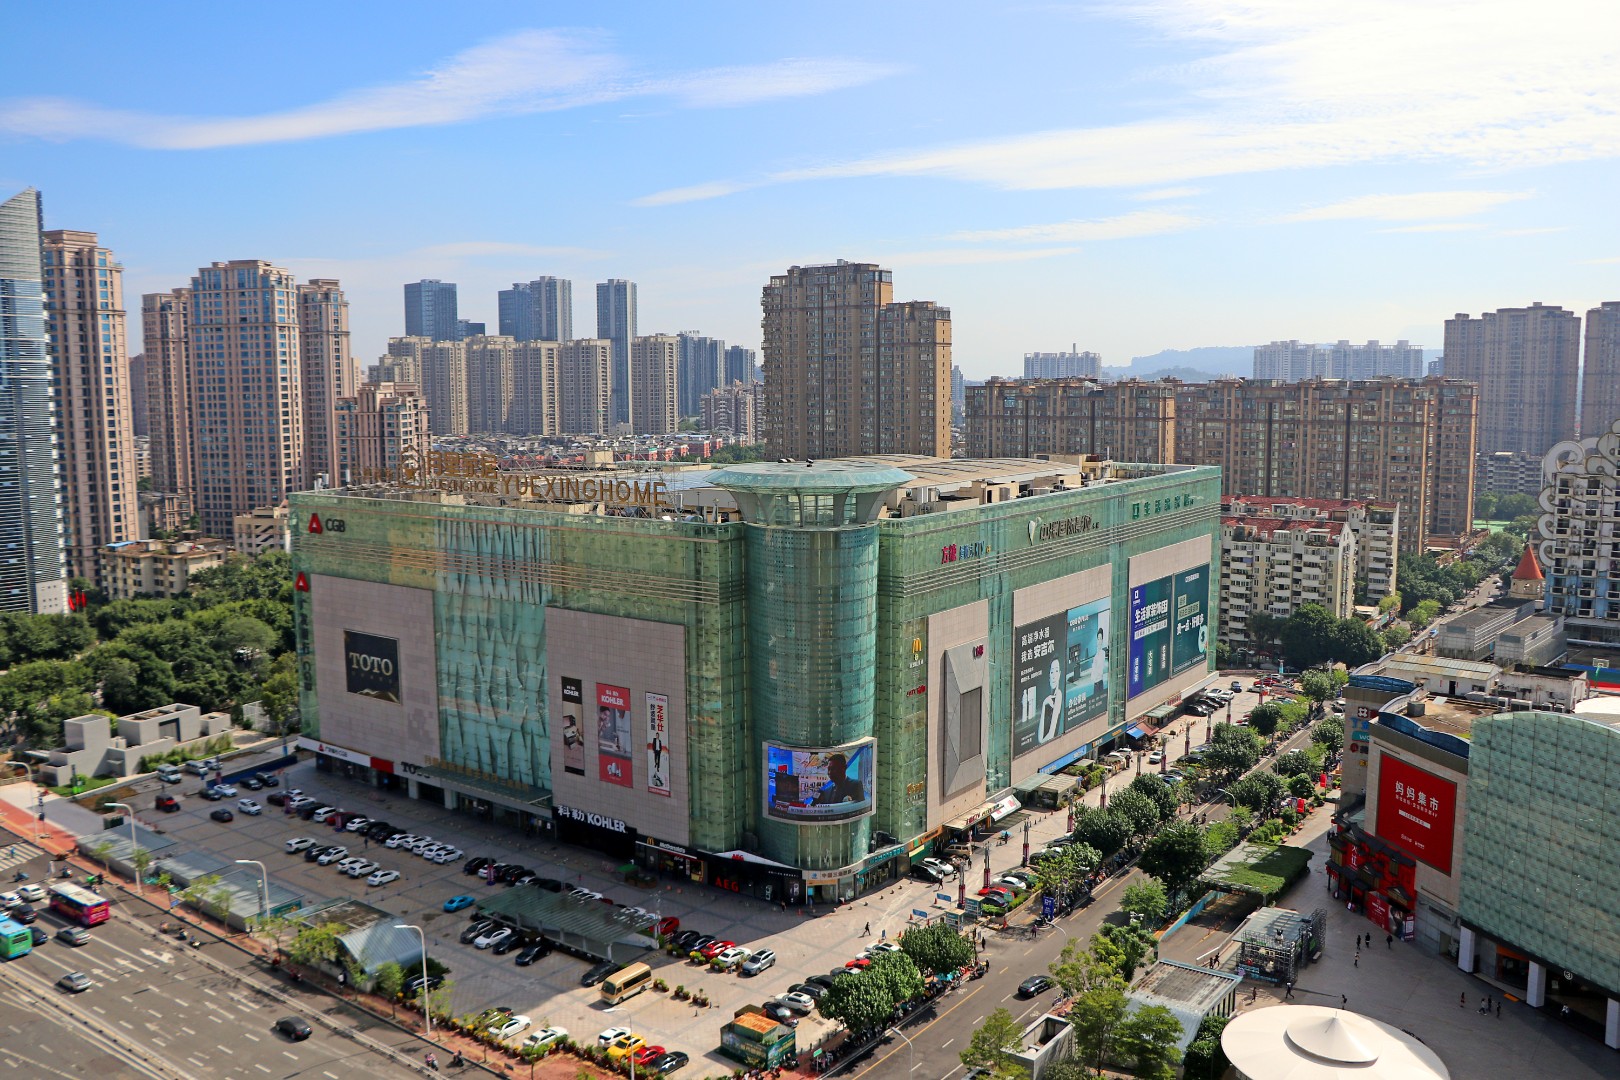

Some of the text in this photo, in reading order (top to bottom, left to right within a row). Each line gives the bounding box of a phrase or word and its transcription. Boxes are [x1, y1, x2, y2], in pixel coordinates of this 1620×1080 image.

[500, 473, 668, 507] YUEXINGHOME
[325, 518, 346, 532] CGB
[1021, 626, 1050, 648] 高端净水器
[349, 652, 393, 676] TOTO
[563, 689, 579, 697] KOHLER
[601, 695, 625, 706] KOHLER
[656, 704, 664, 732] 芝华仕
[1395, 780, 1438, 811] 妈妈集市
[587, 812, 626, 834] KOHLER
[659, 842, 686, 853] McDonald's
[715, 876, 739, 893] AEG
